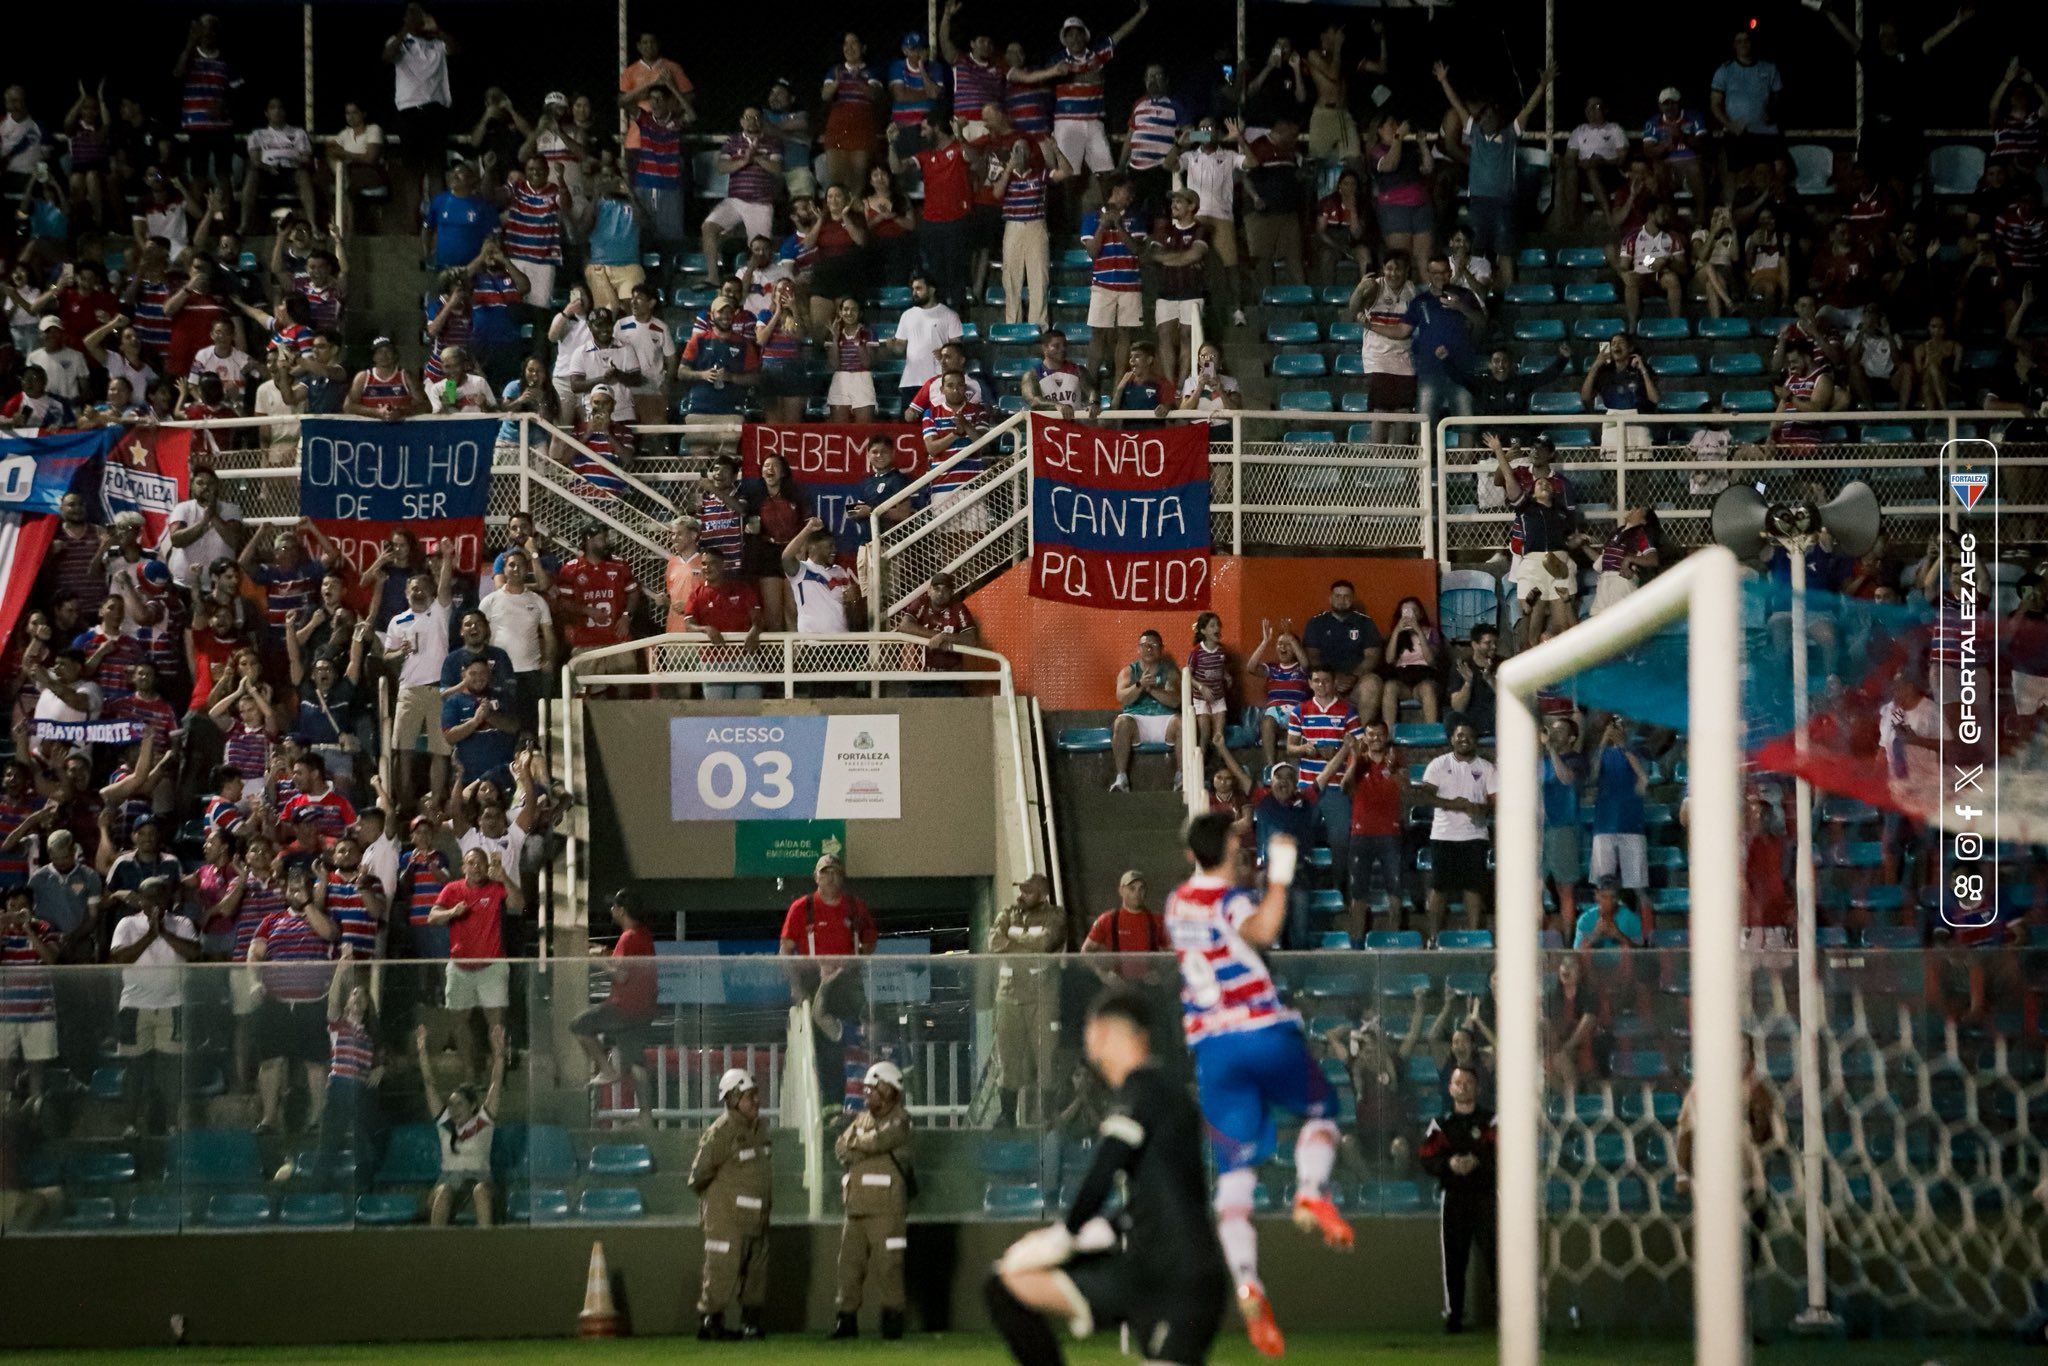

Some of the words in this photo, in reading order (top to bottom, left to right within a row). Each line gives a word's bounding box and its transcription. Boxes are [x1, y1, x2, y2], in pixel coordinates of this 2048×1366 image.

[308, 436, 479, 490] ORGULHO
[757, 426, 917, 474] BEBEMS
[1043, 426, 1083, 473] SE
[1095, 433, 1165, 477] NÃO
[336, 493, 372, 521] DE
[402, 492, 448, 520] SER
[1051, 486, 1185, 539] CANTA
[1041, 552, 1092, 597] PQ
[1106, 557, 1208, 604] VEIO?
[86, 722, 132, 742] NORTE
[705, 727, 785, 743] ACESSO
[697, 750, 794, 810] 03
